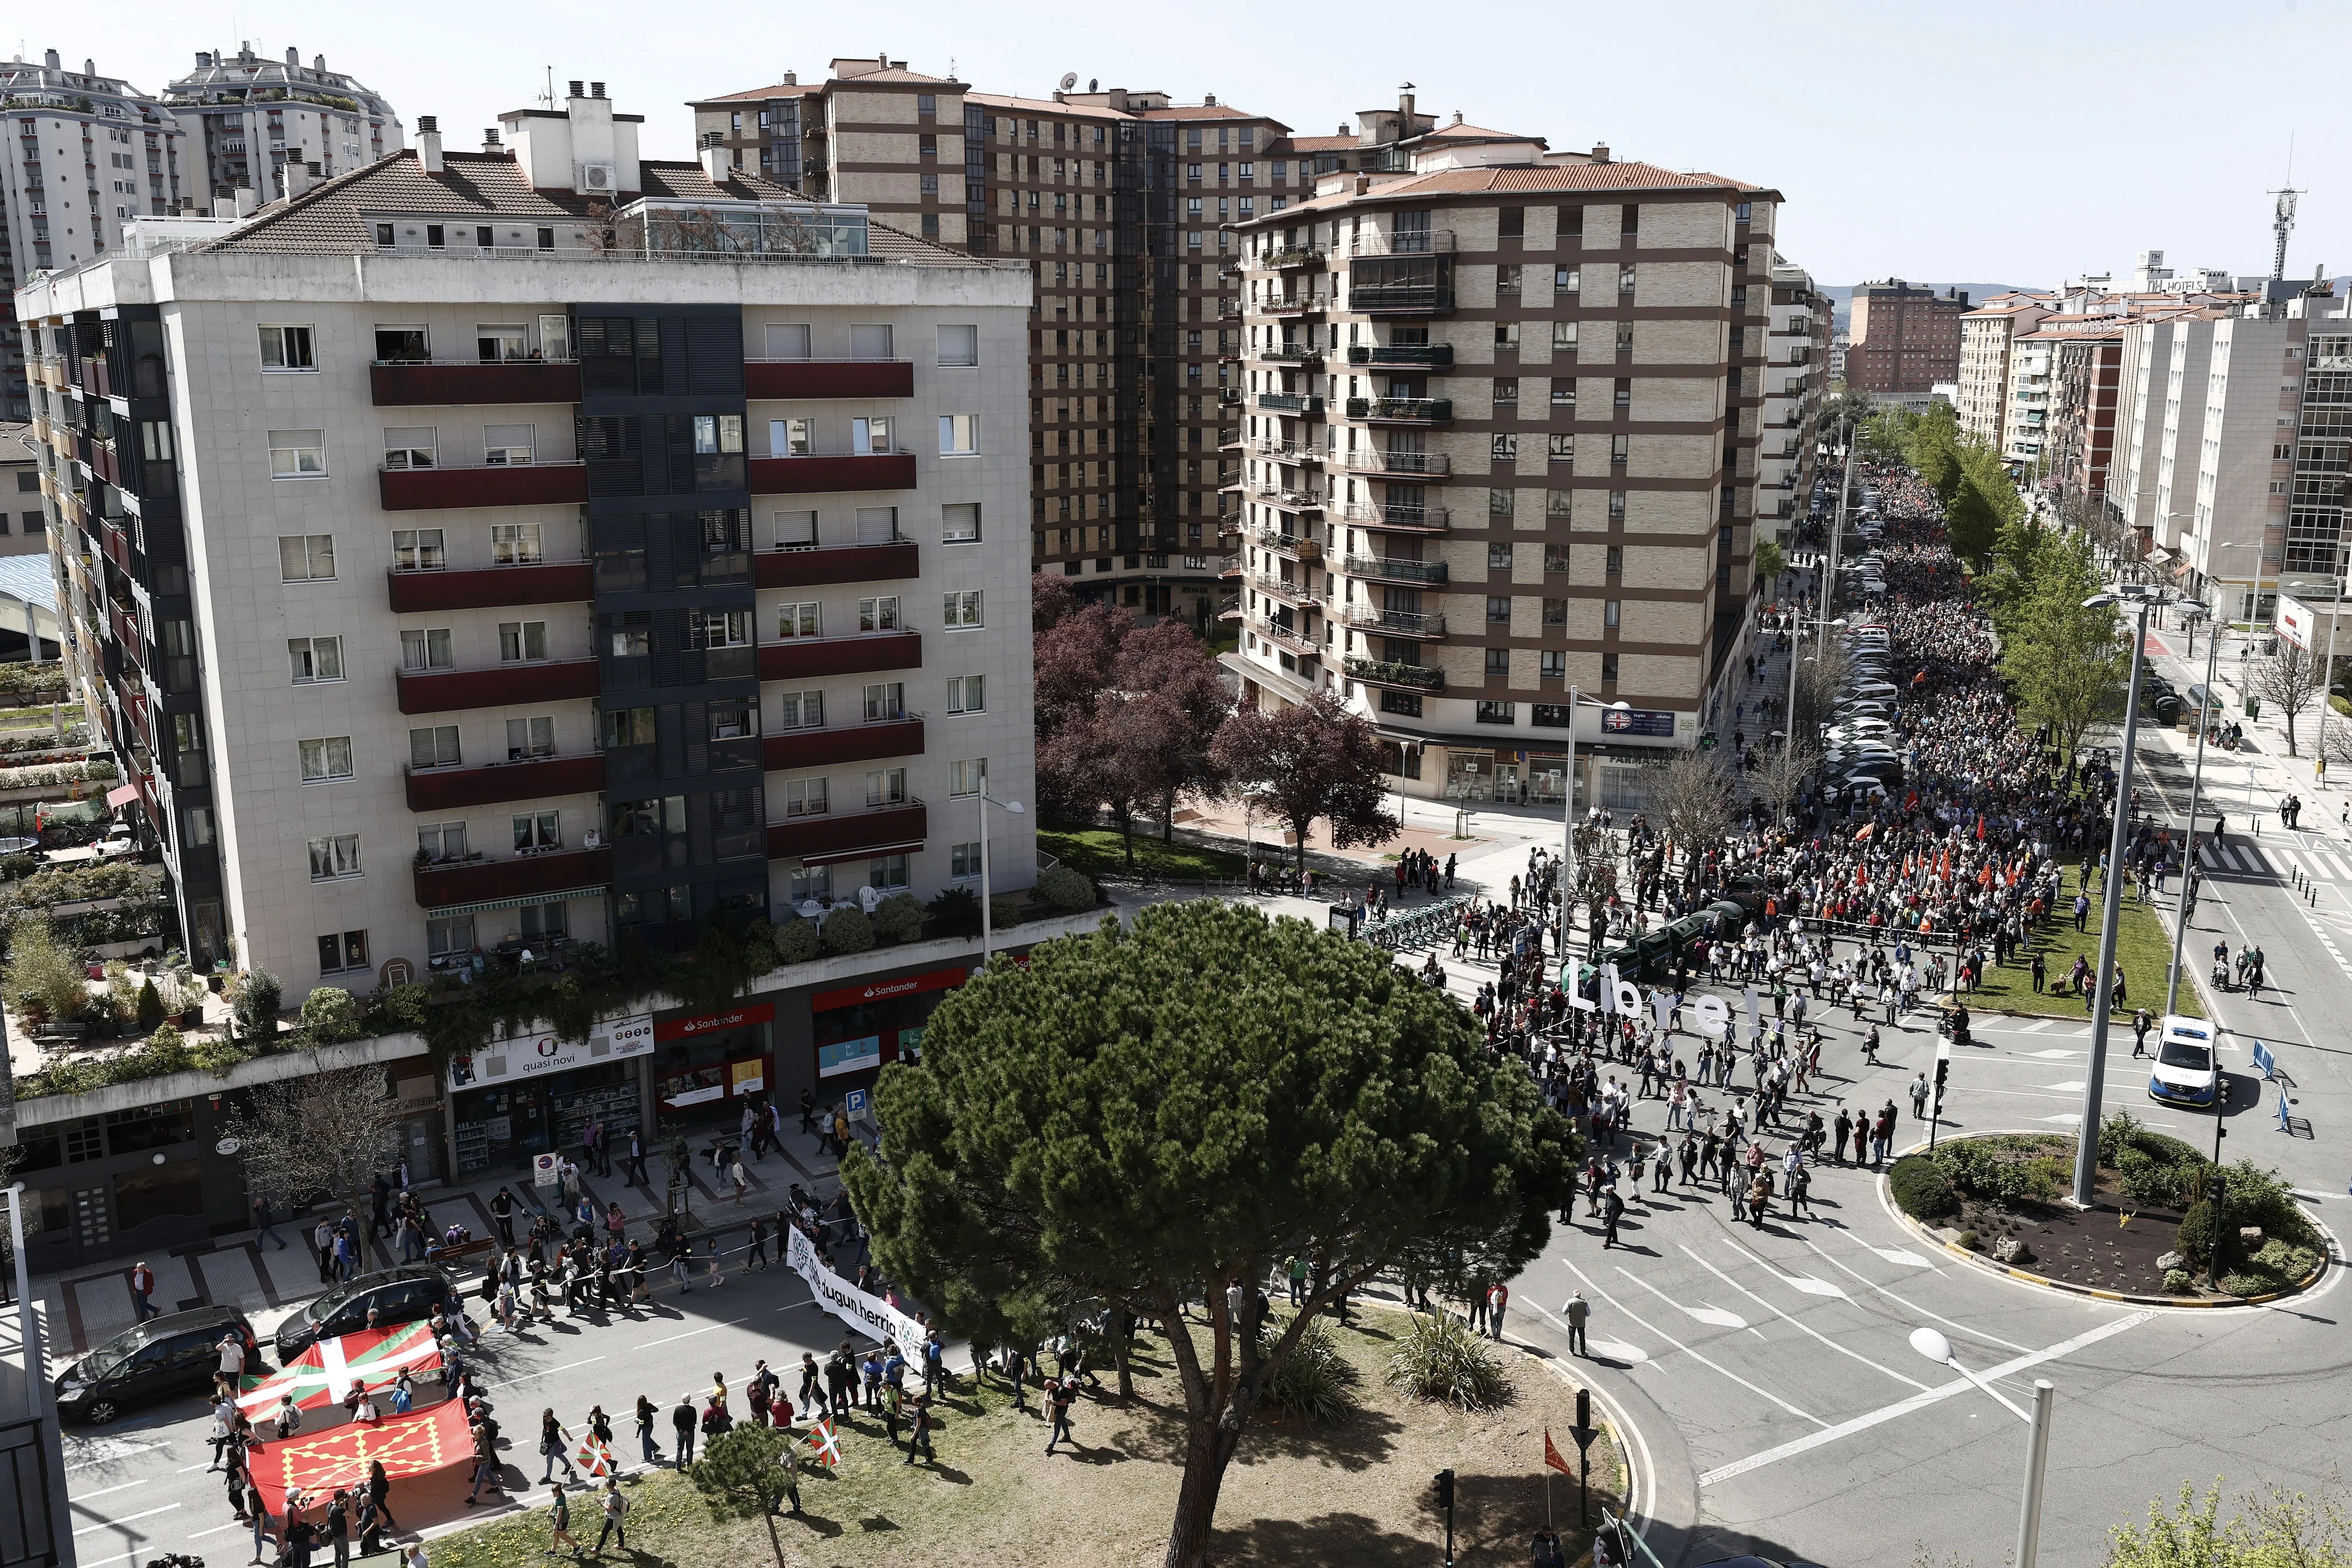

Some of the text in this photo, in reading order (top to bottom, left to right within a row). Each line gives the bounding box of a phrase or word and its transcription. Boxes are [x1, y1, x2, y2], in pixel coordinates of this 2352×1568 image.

[2168, 281, 2203, 291] HOTELS
[876, 982, 918, 995] Santander
[697, 1014, 743, 1029] Santander
[523, 1054, 575, 1072] quasi novi
[851, 1094, 861, 1109] P
[822, 1279, 857, 1314] dugun
[859, 1300, 896, 1337] herria
